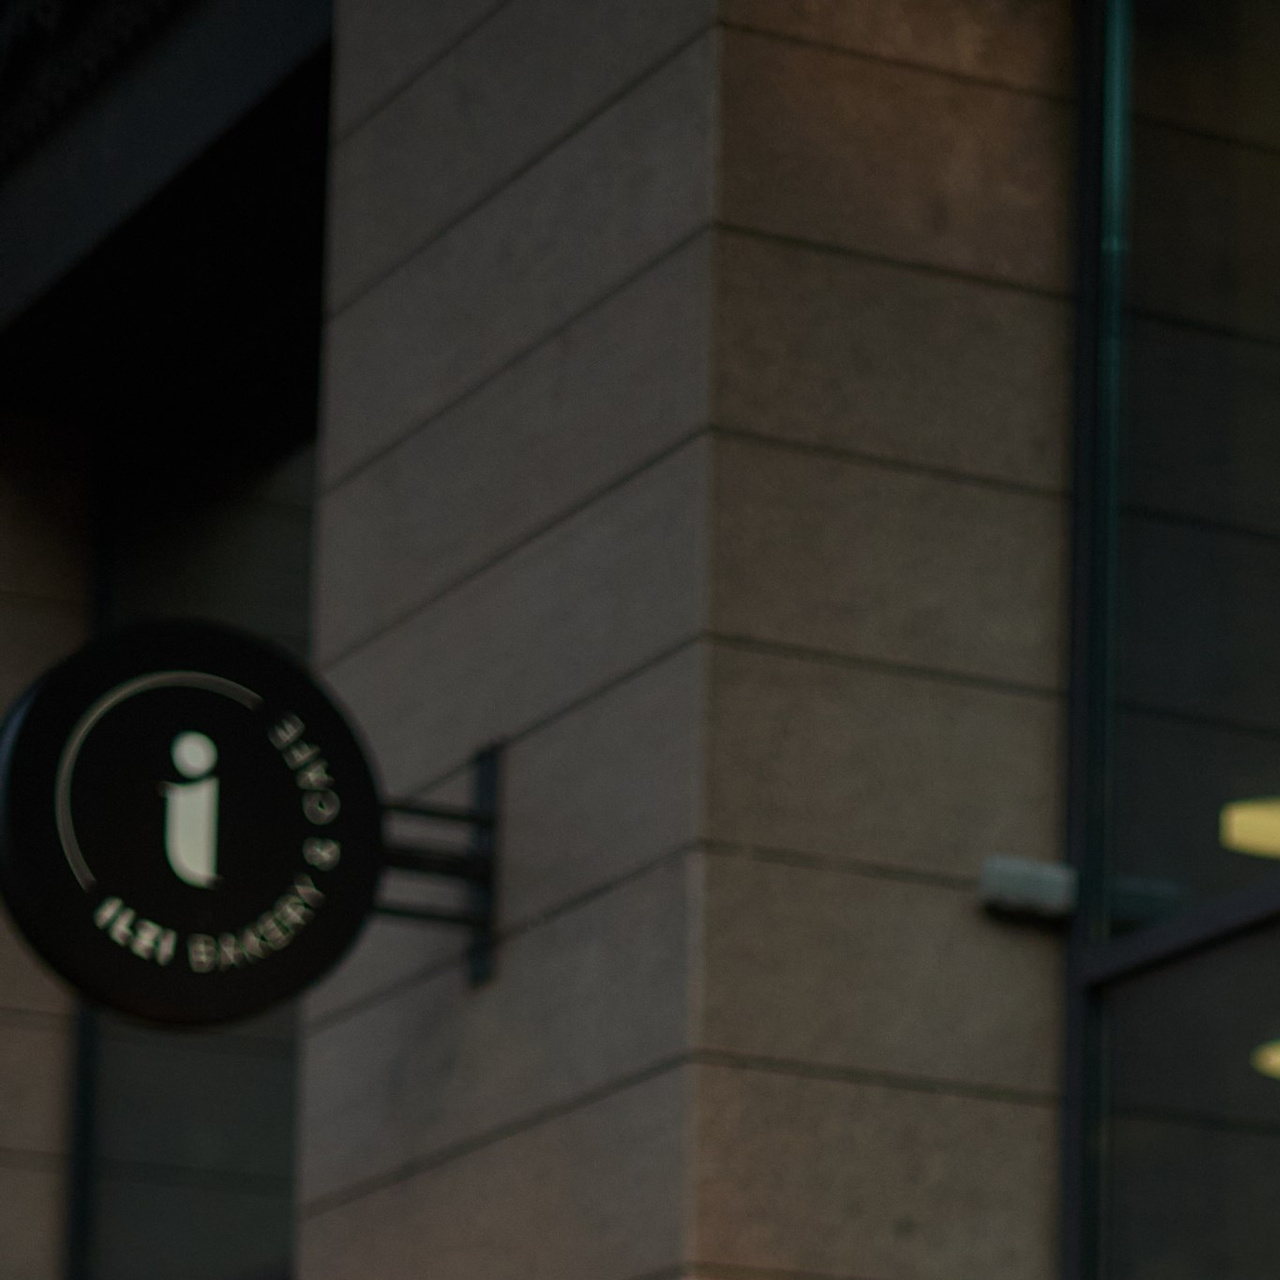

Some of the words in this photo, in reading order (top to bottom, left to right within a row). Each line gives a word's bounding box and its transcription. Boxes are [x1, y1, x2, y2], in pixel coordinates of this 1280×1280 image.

[268, 714, 341, 826] CAFE
[303, 836, 341, 871] &
[188, 873, 325, 973] BAKERY
